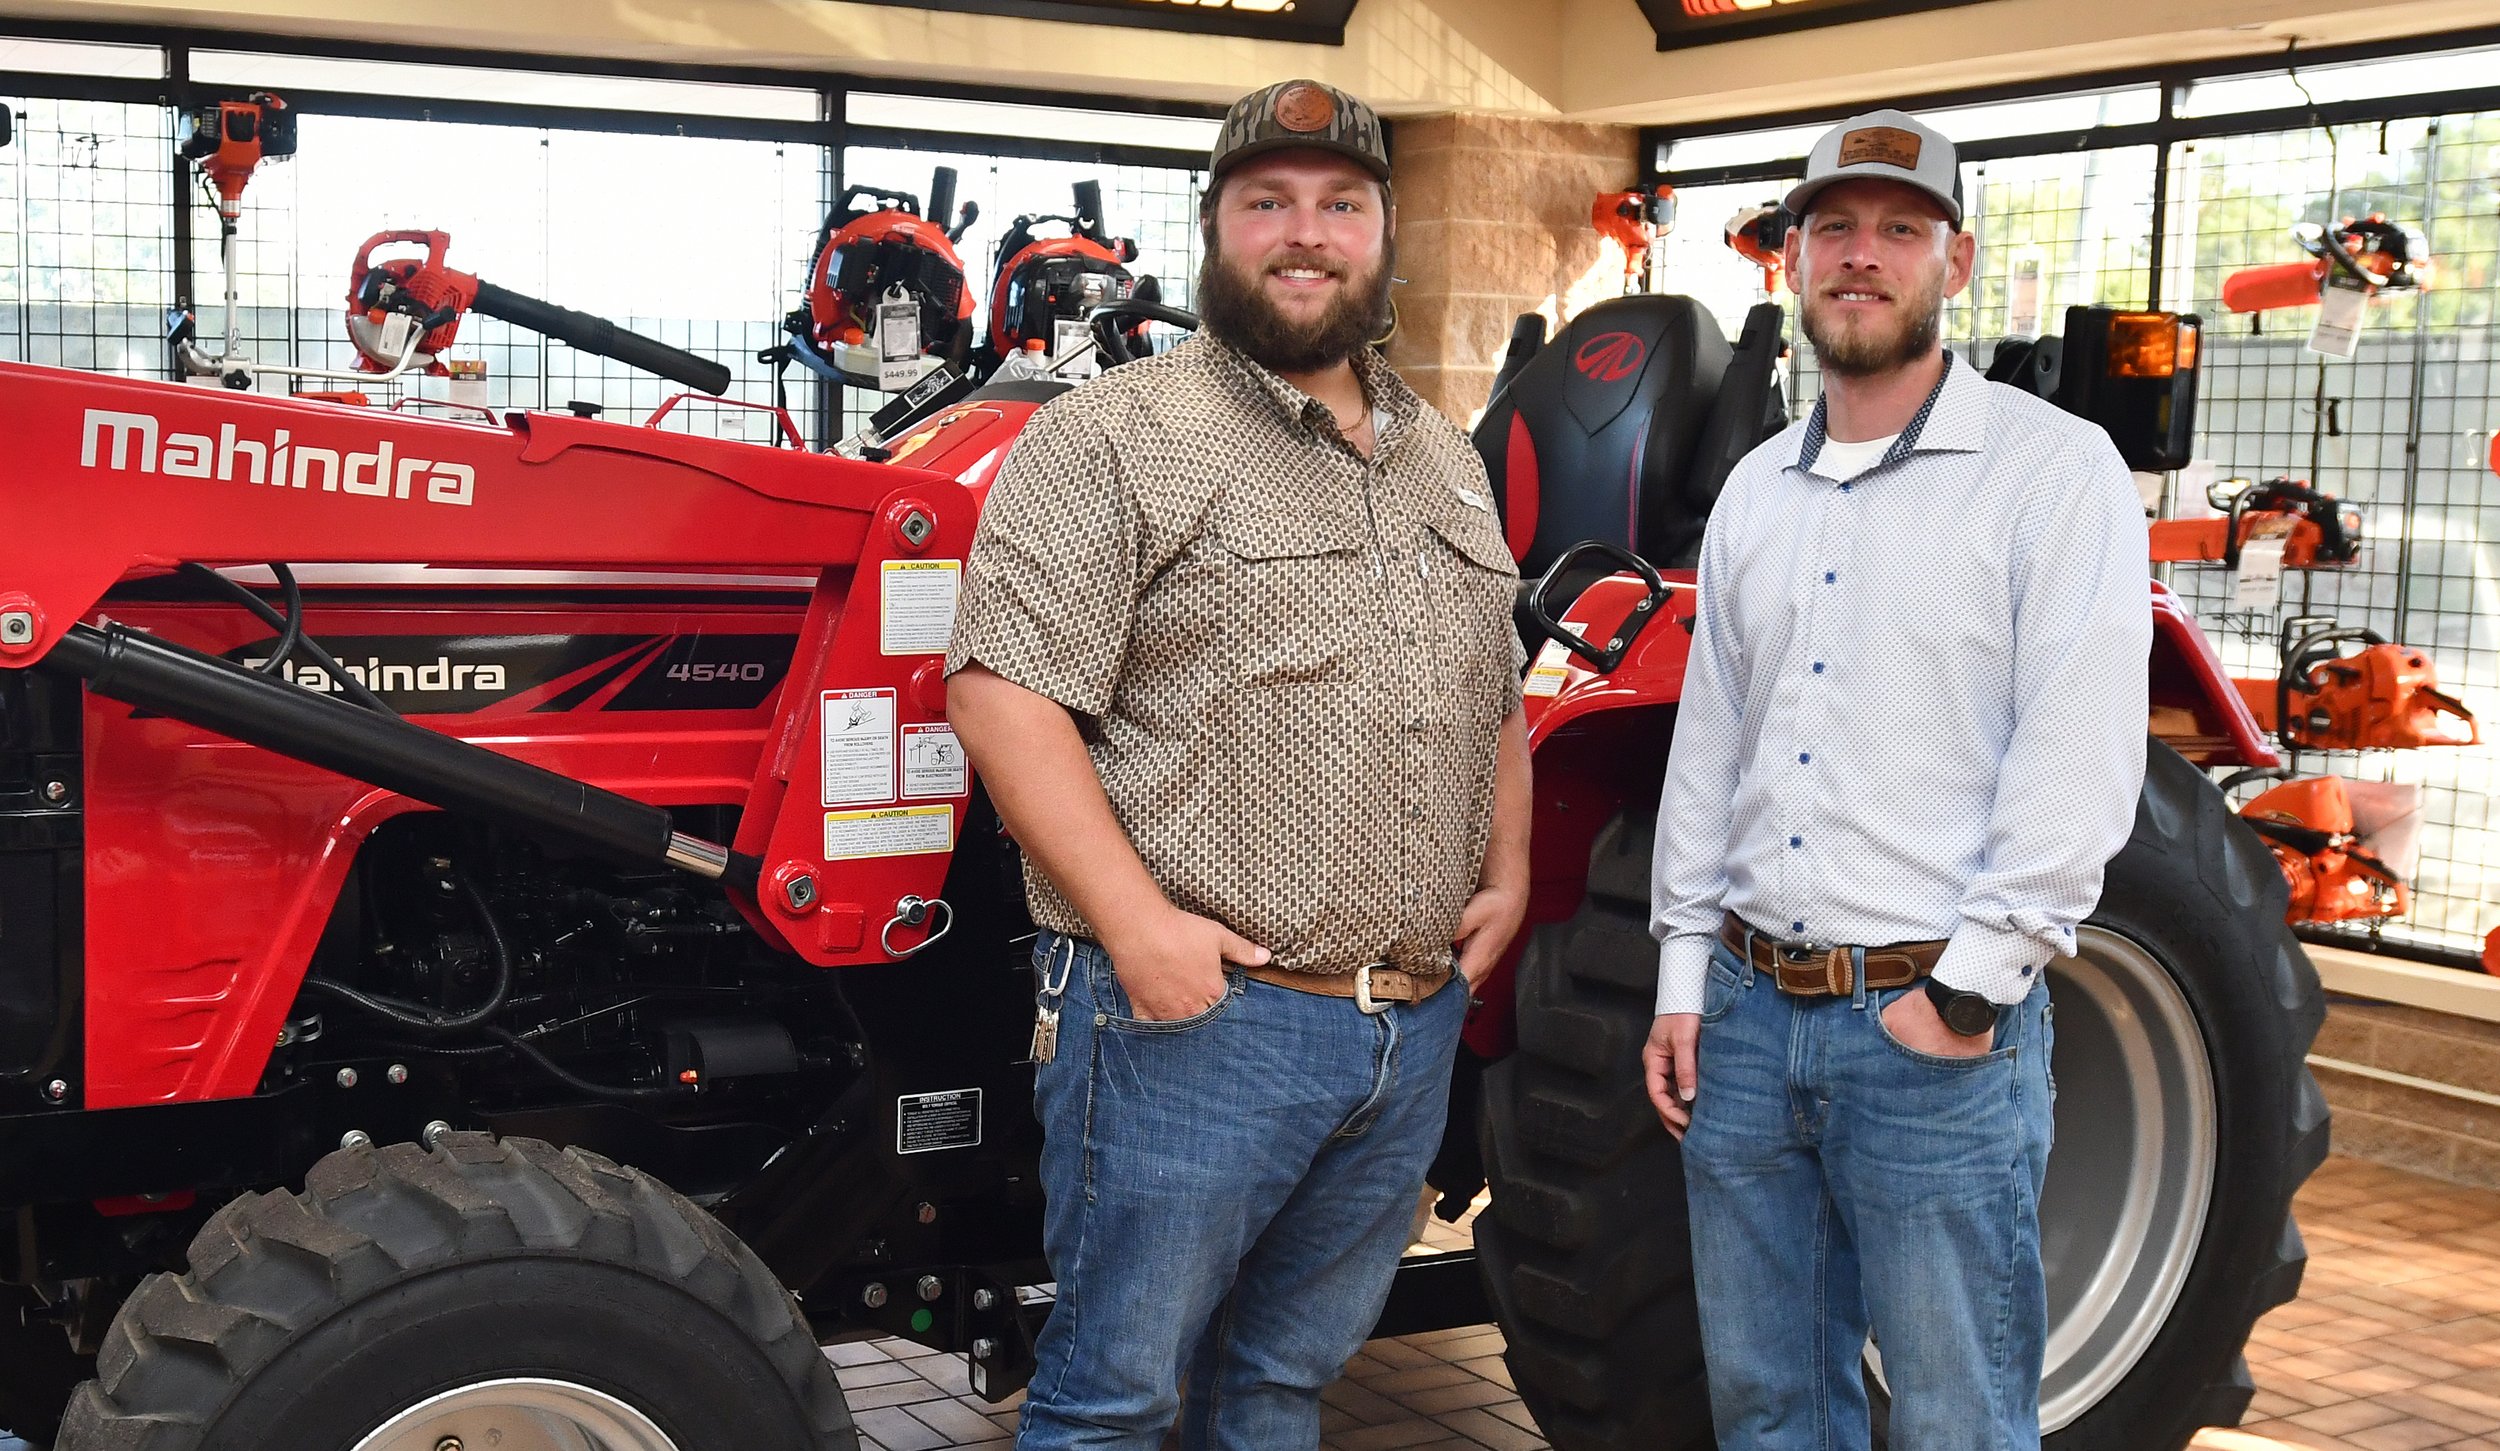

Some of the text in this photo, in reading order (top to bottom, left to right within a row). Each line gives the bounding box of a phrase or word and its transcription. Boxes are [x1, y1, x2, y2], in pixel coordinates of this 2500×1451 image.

[884, 369, 918, 379] $449.99
[80, 407, 476, 507] Mahindra
[666, 663, 765, 682] 4540
[879, 810, 909, 818] CAUTION
[919, 1093, 961, 1103] INSTRUCTION
